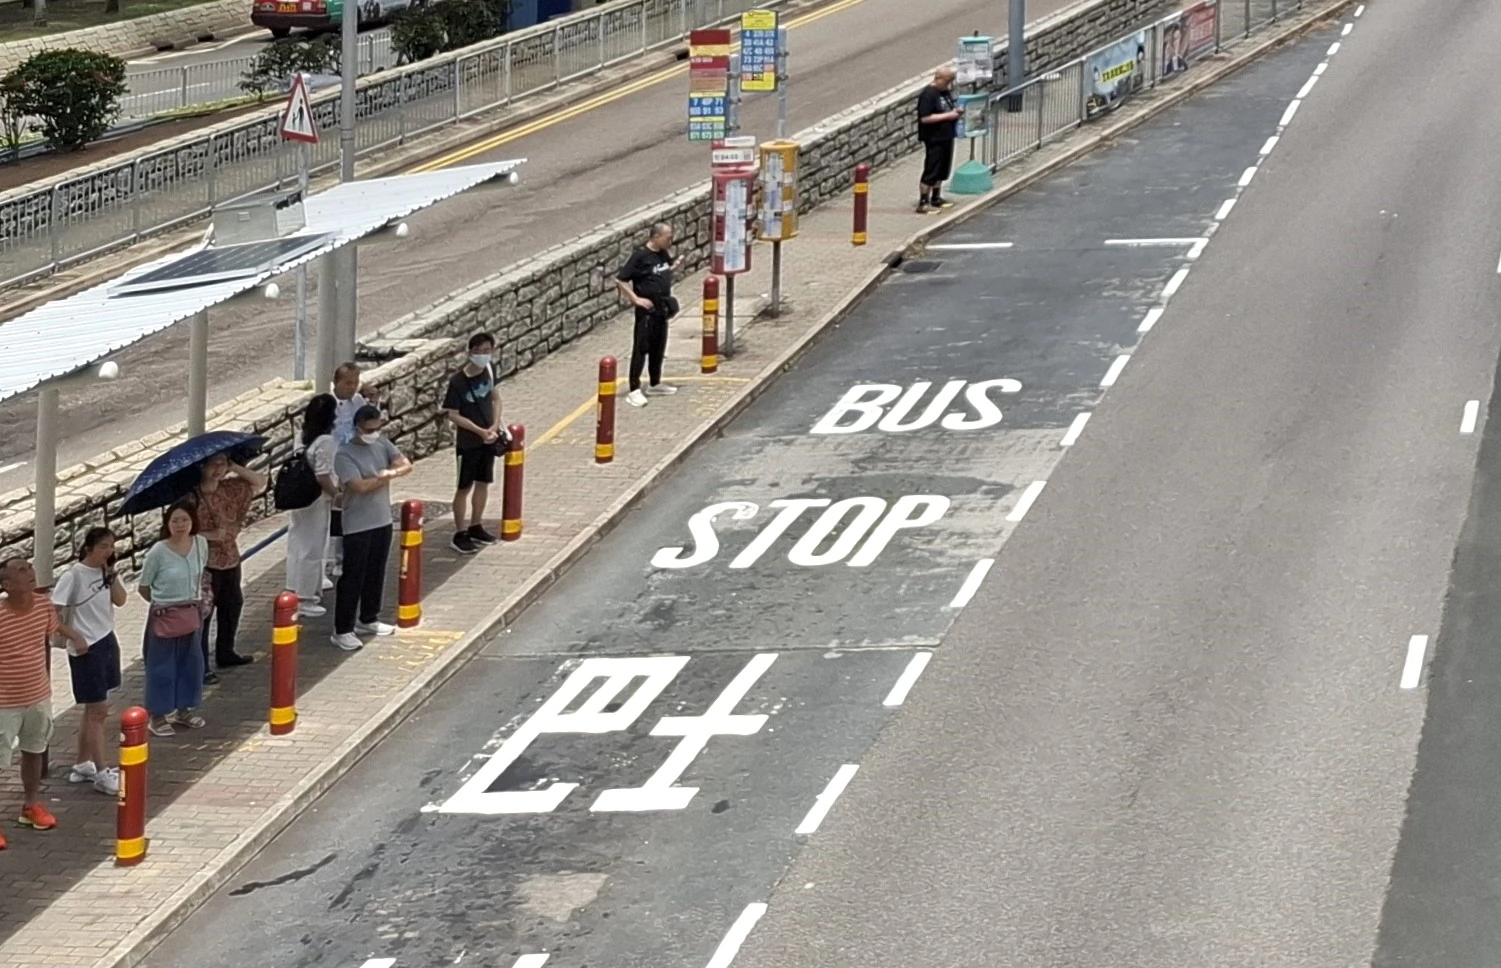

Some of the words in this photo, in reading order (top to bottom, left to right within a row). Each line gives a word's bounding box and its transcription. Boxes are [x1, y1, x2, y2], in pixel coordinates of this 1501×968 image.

[810, 379, 1022, 436] BUS
[650, 494, 951, 569] STOP
[438, 653, 779, 814] 巴士
